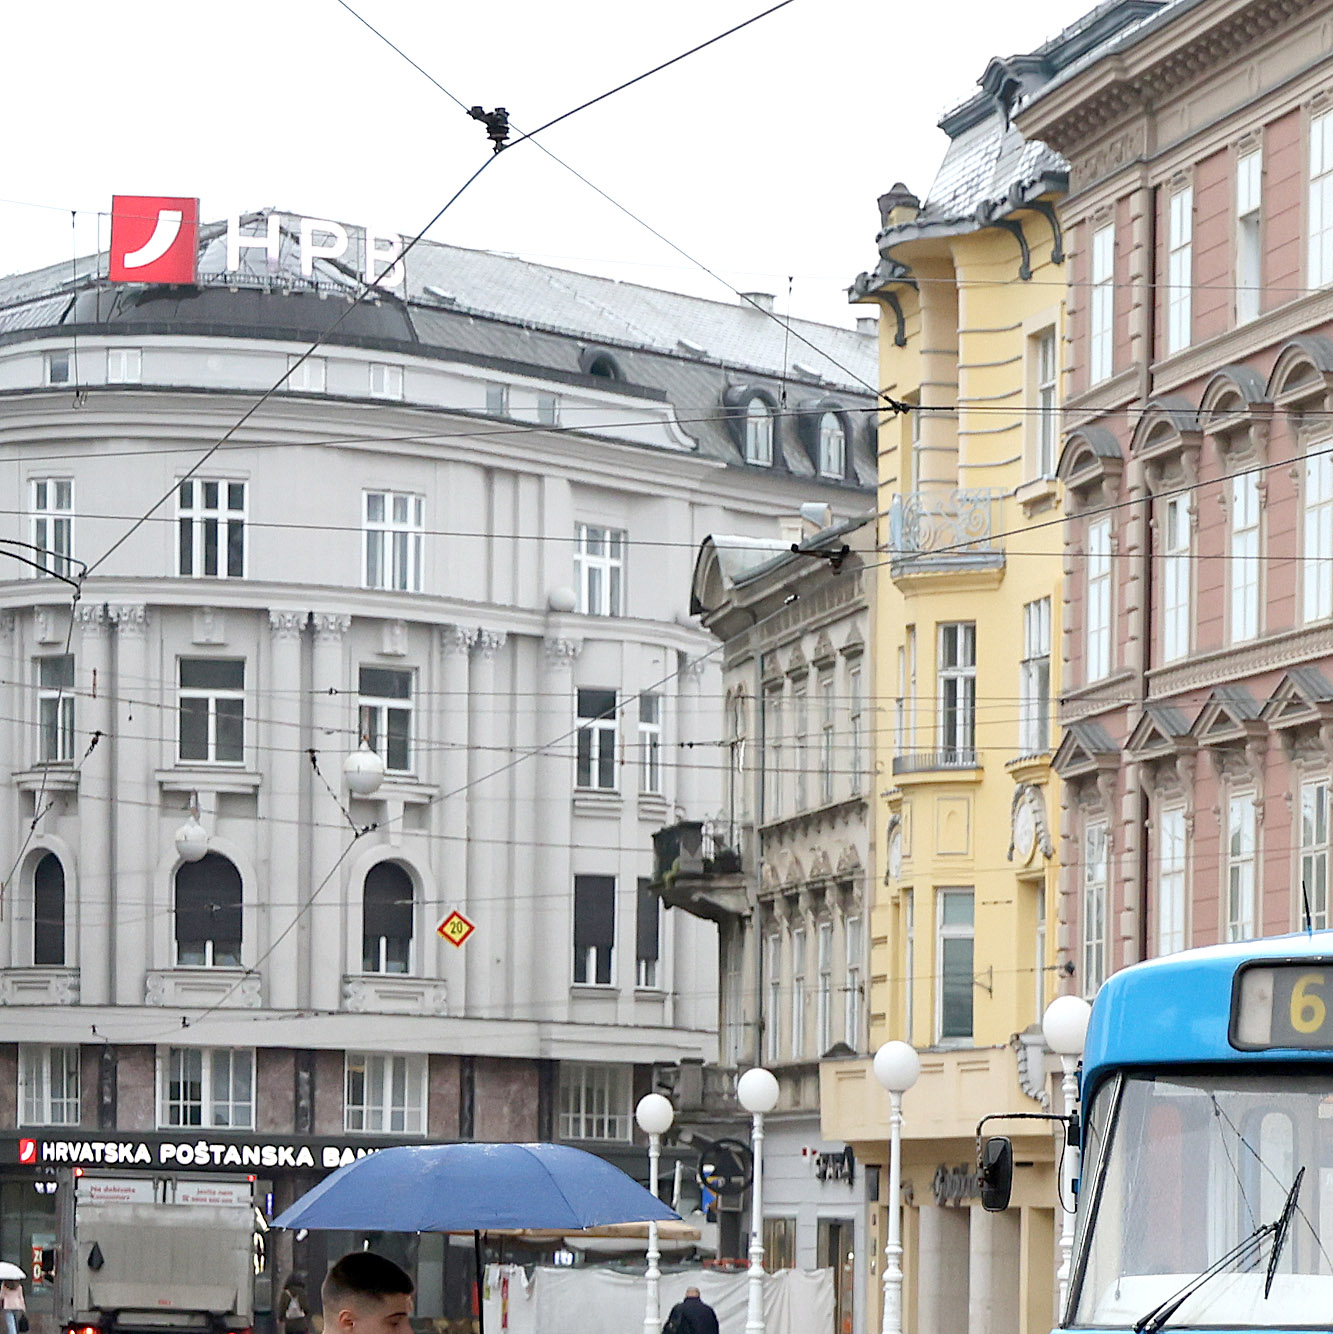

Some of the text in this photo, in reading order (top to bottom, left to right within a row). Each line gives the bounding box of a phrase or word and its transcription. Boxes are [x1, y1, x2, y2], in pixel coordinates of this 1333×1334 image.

[226, 204, 406, 287] HPB
[450, 920, 463, 934] 20
[1290, 973, 1326, 1033] 6
[42, 1141, 151, 1164] HRVATSKA
[160, 1141, 314, 1168] POŠTANSKA
